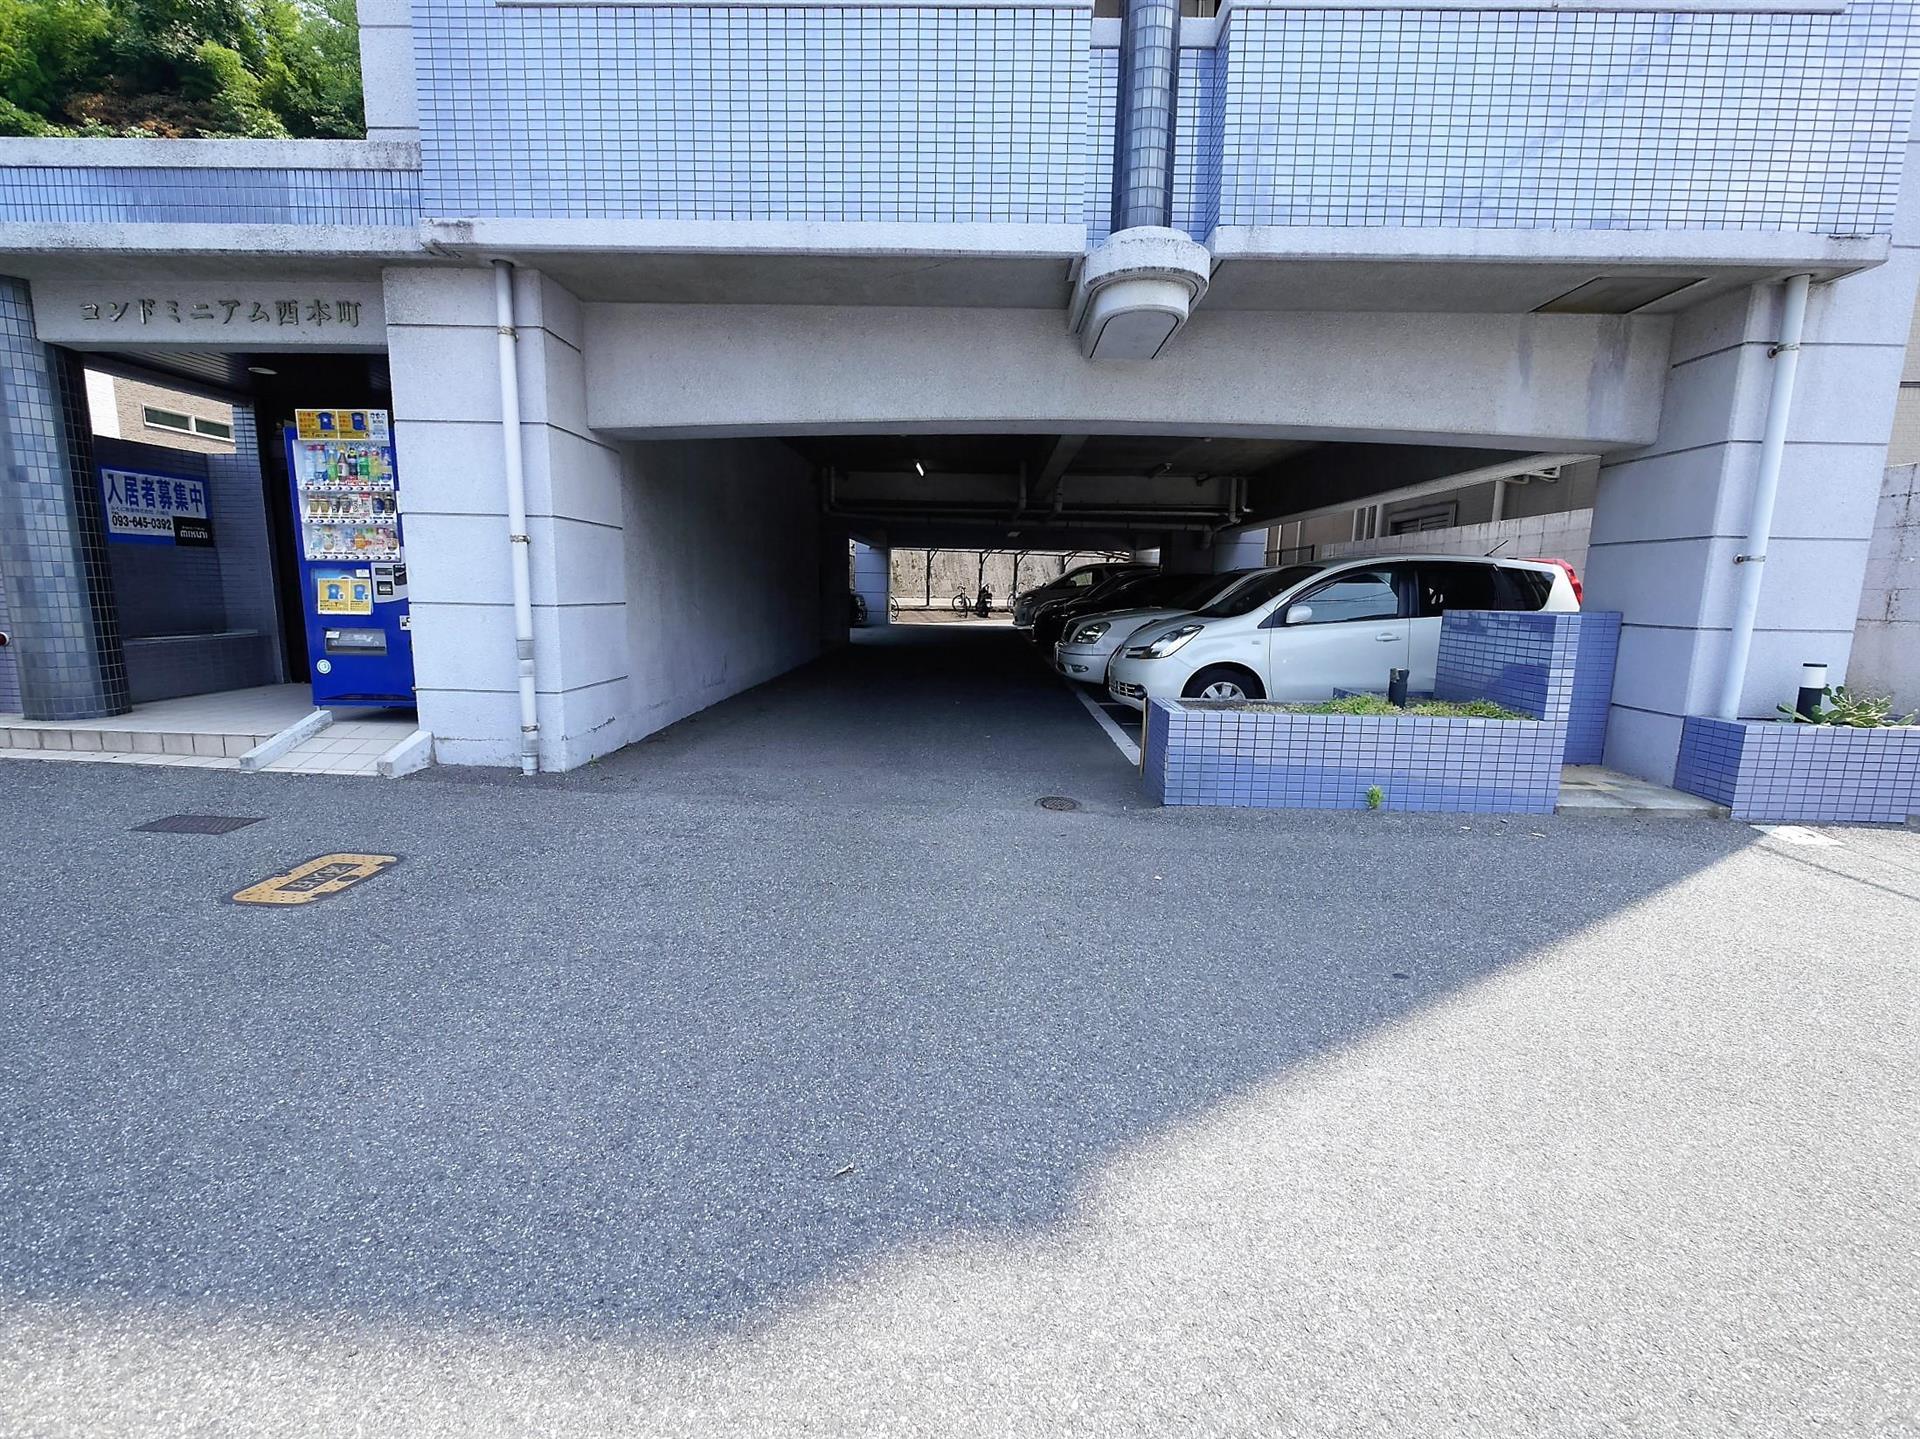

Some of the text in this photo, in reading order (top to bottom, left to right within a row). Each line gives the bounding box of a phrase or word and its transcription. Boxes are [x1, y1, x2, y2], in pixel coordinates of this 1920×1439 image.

[80, 299, 362, 328] コンドミニアム西本町
[107, 473, 203, 513] 入居者募集中
[111, 514, 173, 531] 093-645-0392
